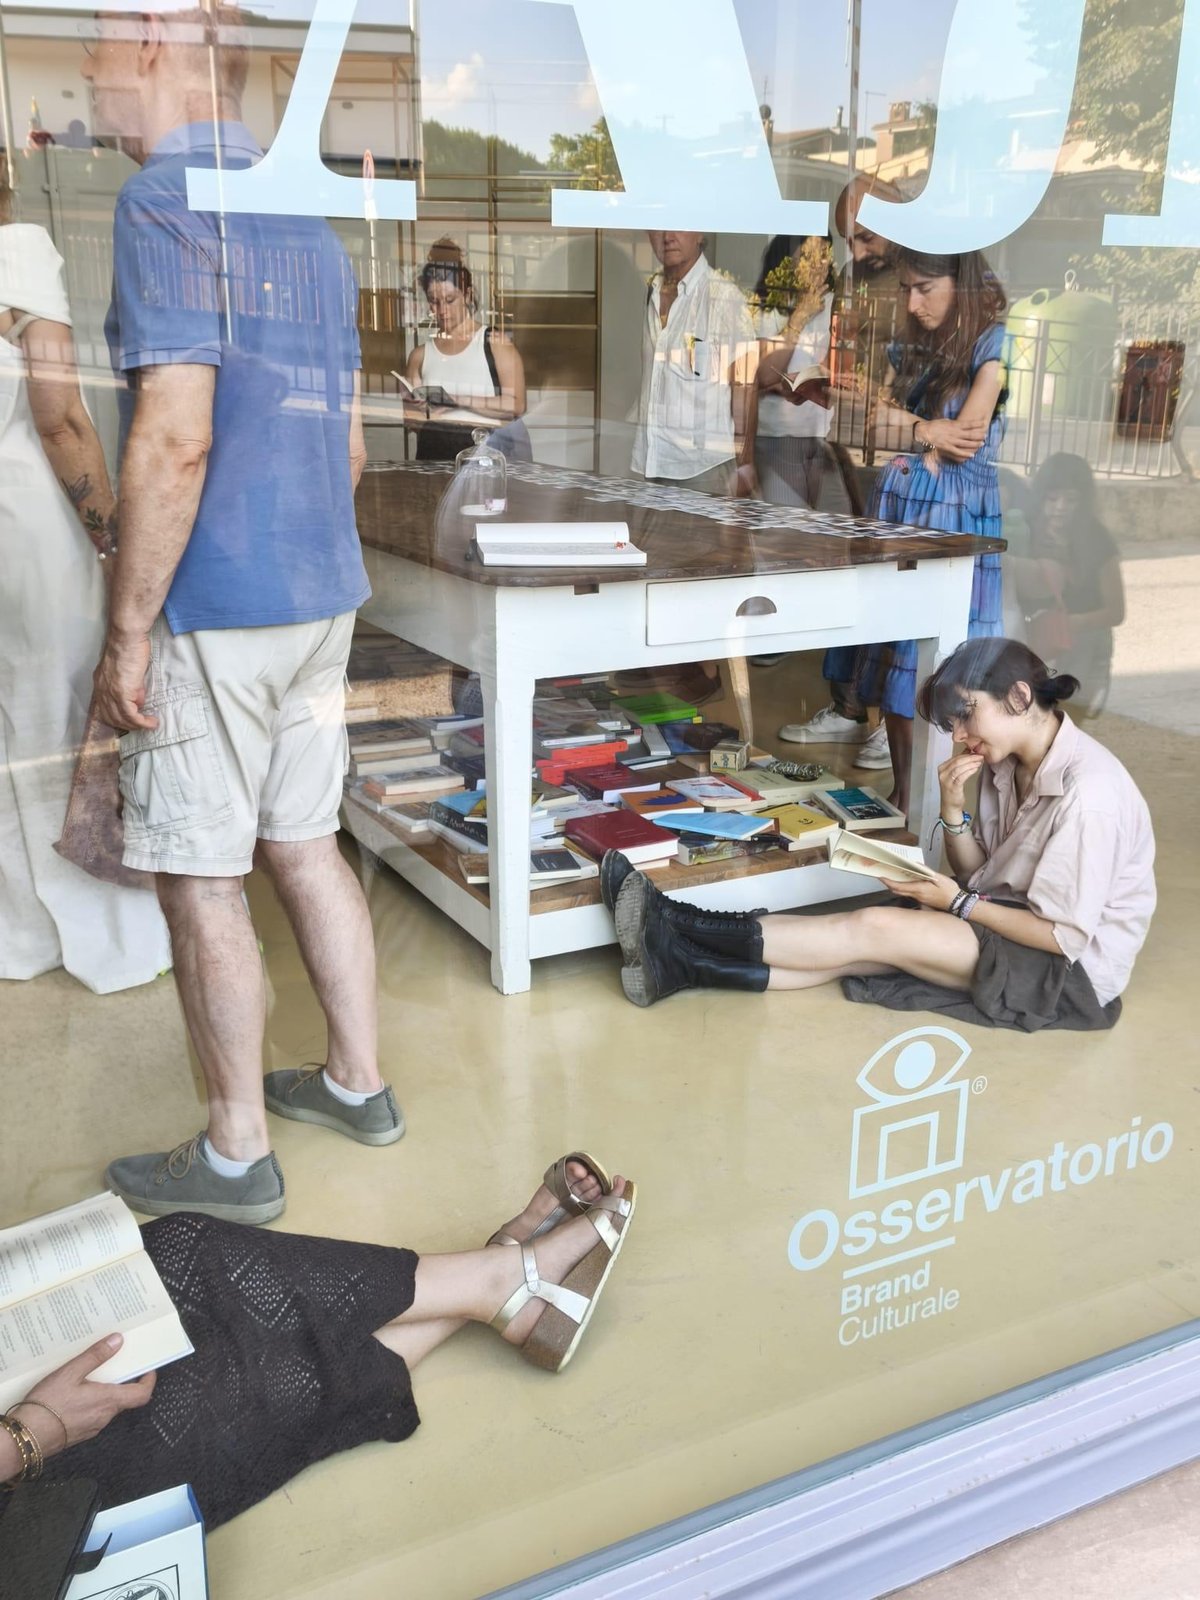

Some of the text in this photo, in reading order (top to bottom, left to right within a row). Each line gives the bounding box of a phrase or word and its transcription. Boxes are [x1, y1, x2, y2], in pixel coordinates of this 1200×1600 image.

[787, 1116, 1174, 1271] Osservatorio
[838, 1286, 960, 1346] Culturale
[840, 1261, 931, 1314] Brand
